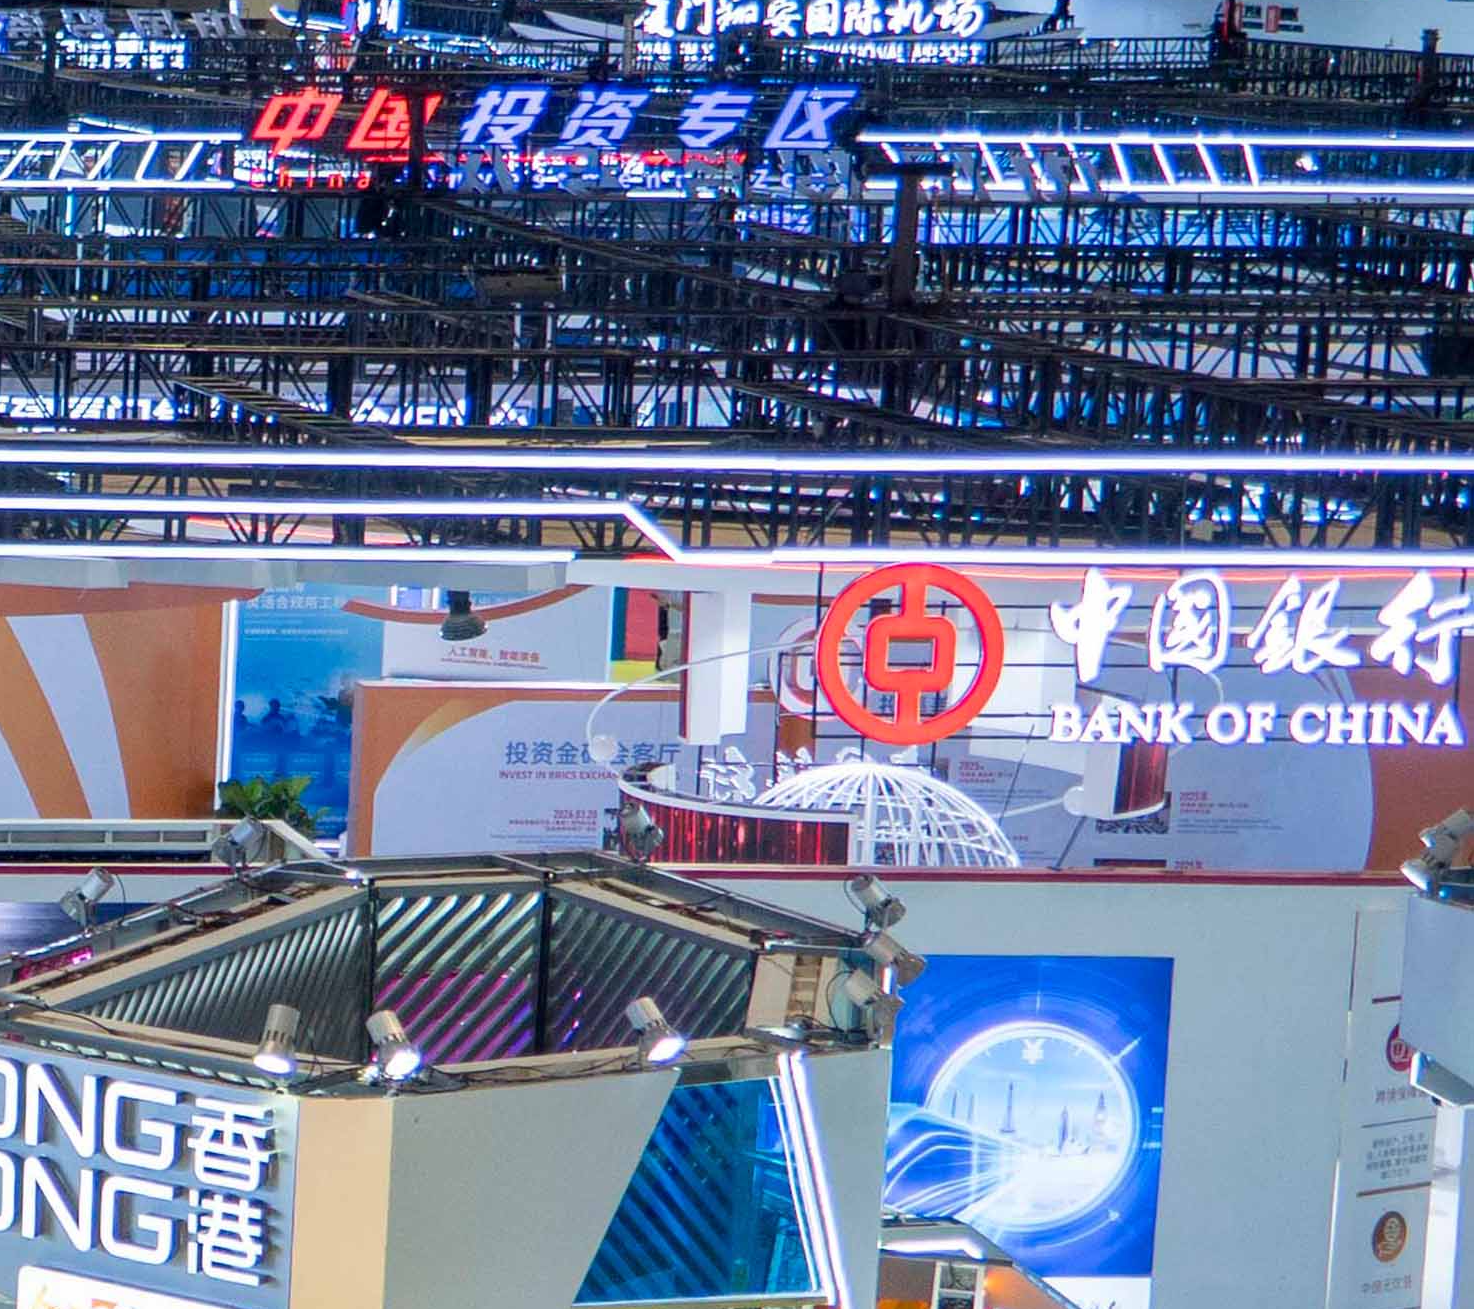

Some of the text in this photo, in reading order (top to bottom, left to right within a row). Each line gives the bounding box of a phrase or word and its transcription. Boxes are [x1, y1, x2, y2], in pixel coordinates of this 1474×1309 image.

[253, 86, 856, 156] 中国 投资专区
[1049, 566, 1474, 686] 中国銀行
[1051, 703, 1465, 745] BANK OF CHINA
[499, 771, 533, 780] INVEST
[186, 1095, 273, 1193] 香
[187, 1189, 270, 1287] 港
